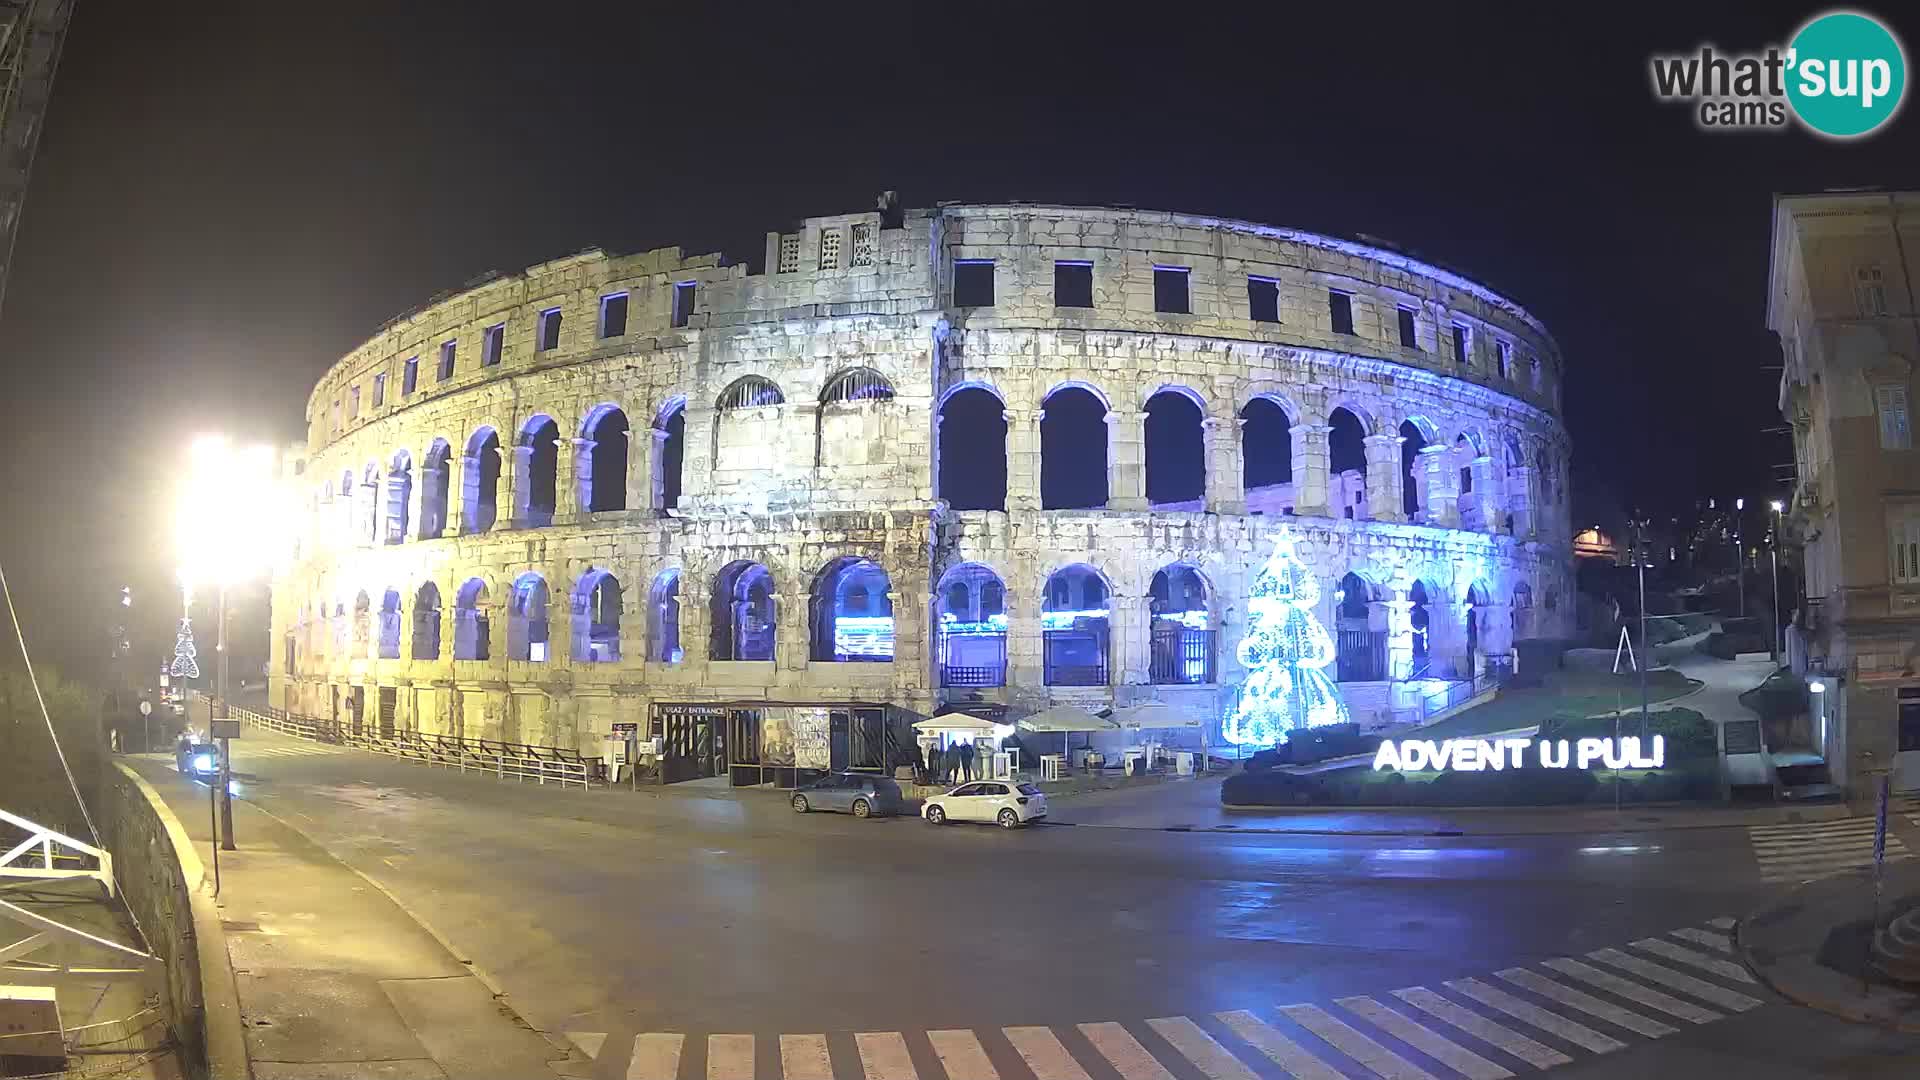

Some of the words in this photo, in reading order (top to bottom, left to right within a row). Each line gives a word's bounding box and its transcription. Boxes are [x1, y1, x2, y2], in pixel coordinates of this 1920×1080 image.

[688, 706, 725, 715] ENTRANCE
[1372, 738, 1531, 771] ADVENT
[1577, 735, 1664, 769] PULI
